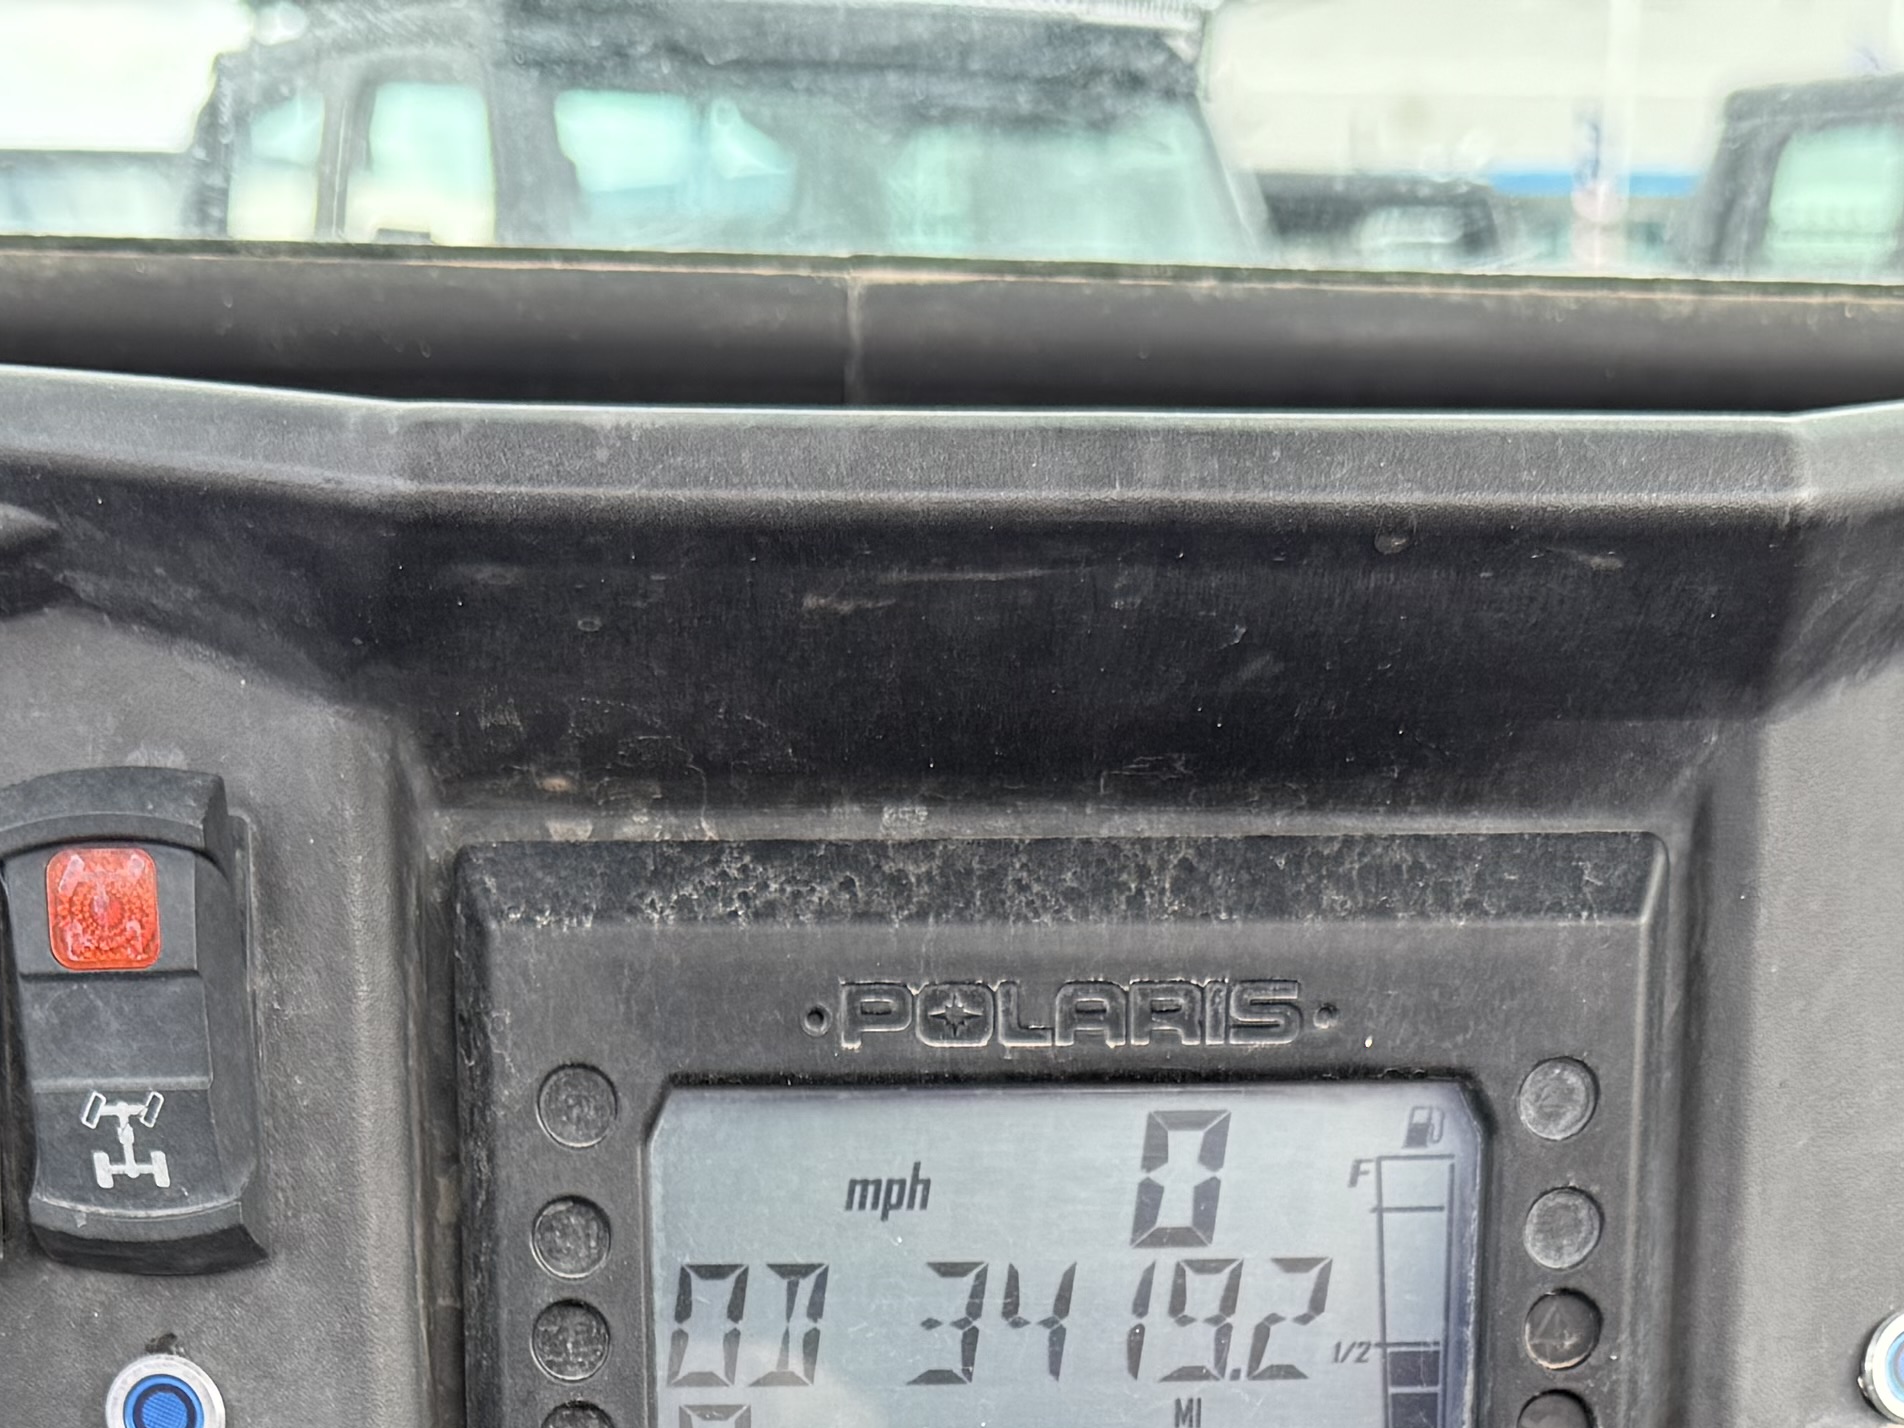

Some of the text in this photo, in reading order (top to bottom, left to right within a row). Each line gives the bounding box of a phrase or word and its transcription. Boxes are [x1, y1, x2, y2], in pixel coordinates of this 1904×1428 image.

[837, 977, 1303, 1050] POLARIS
[844, 1109, 1232, 1248] mph 0
[1348, 1158, 1377, 1188] F
[1331, 1340, 1373, 1364] 1/2
[1174, 1397, 1202, 1428] MI
